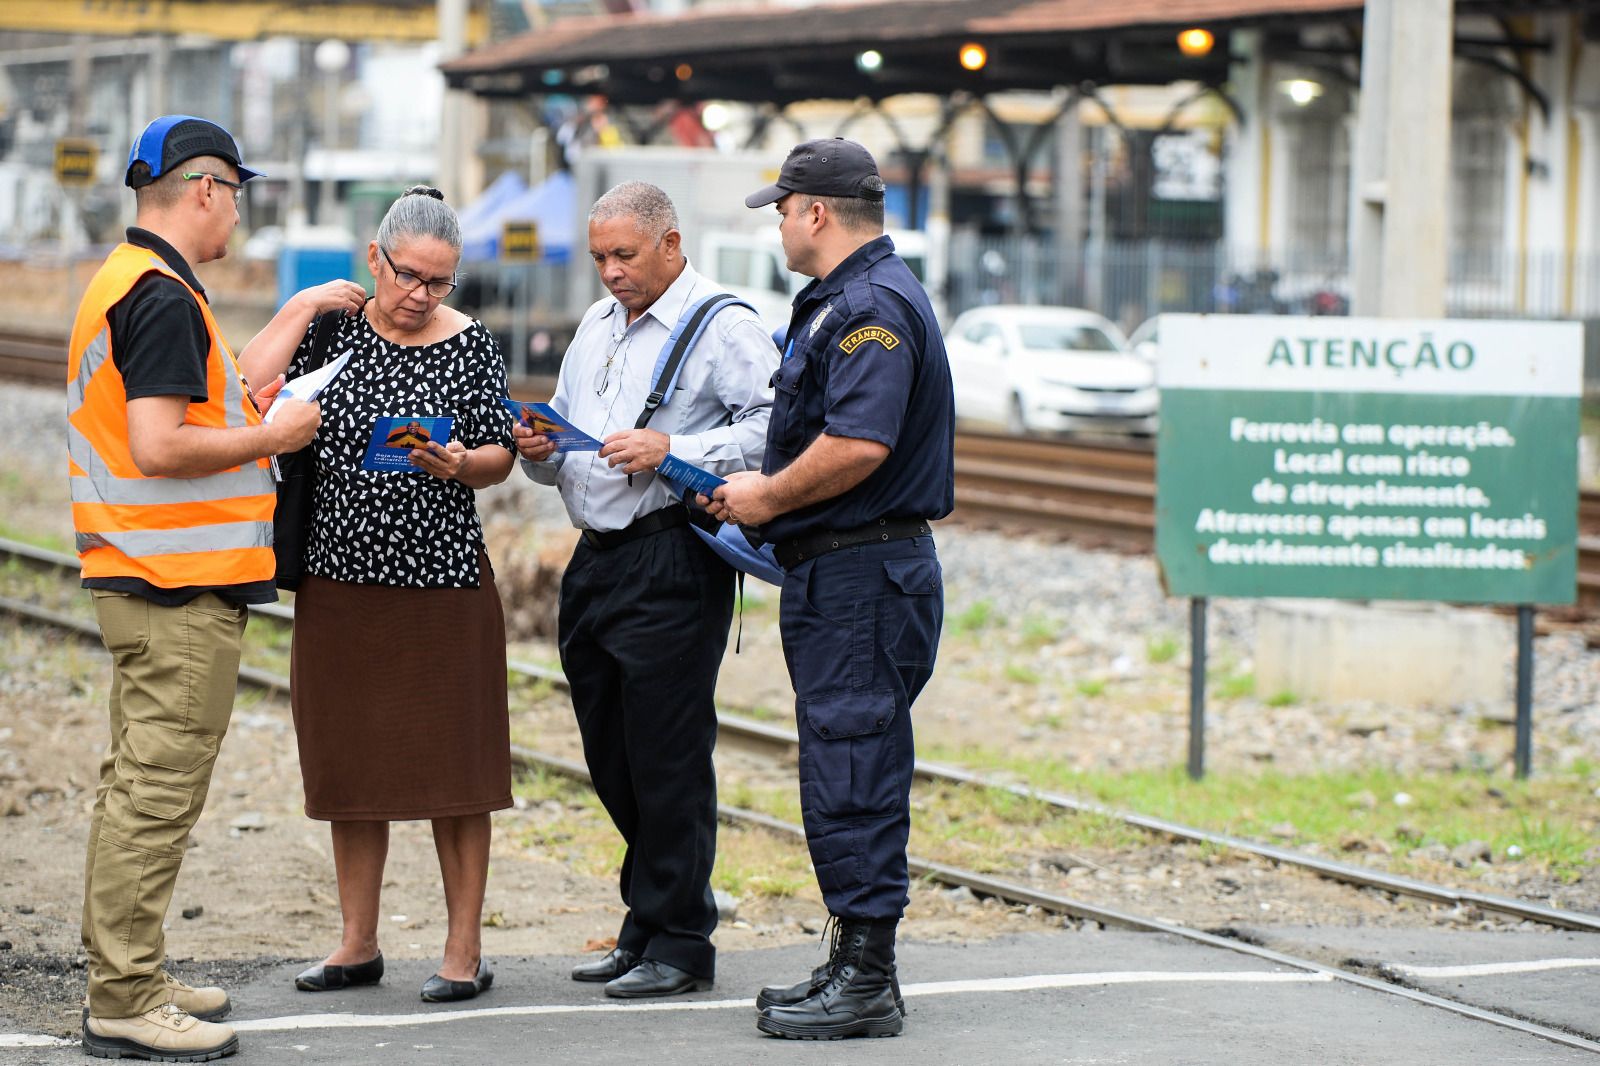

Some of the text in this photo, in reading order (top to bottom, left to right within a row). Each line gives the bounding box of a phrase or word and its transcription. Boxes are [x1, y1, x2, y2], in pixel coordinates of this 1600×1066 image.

[1267, 331, 1475, 377] ATENÇÃO
[1230, 417, 1515, 452] Ferrovia em operação.
[1274, 448, 1471, 477] Local com risco
[1252, 478, 1490, 511] de atropelamento.
[1196, 508, 1546, 541] Atravesse apenas em locais
[1208, 538, 1379, 566] devidamente
